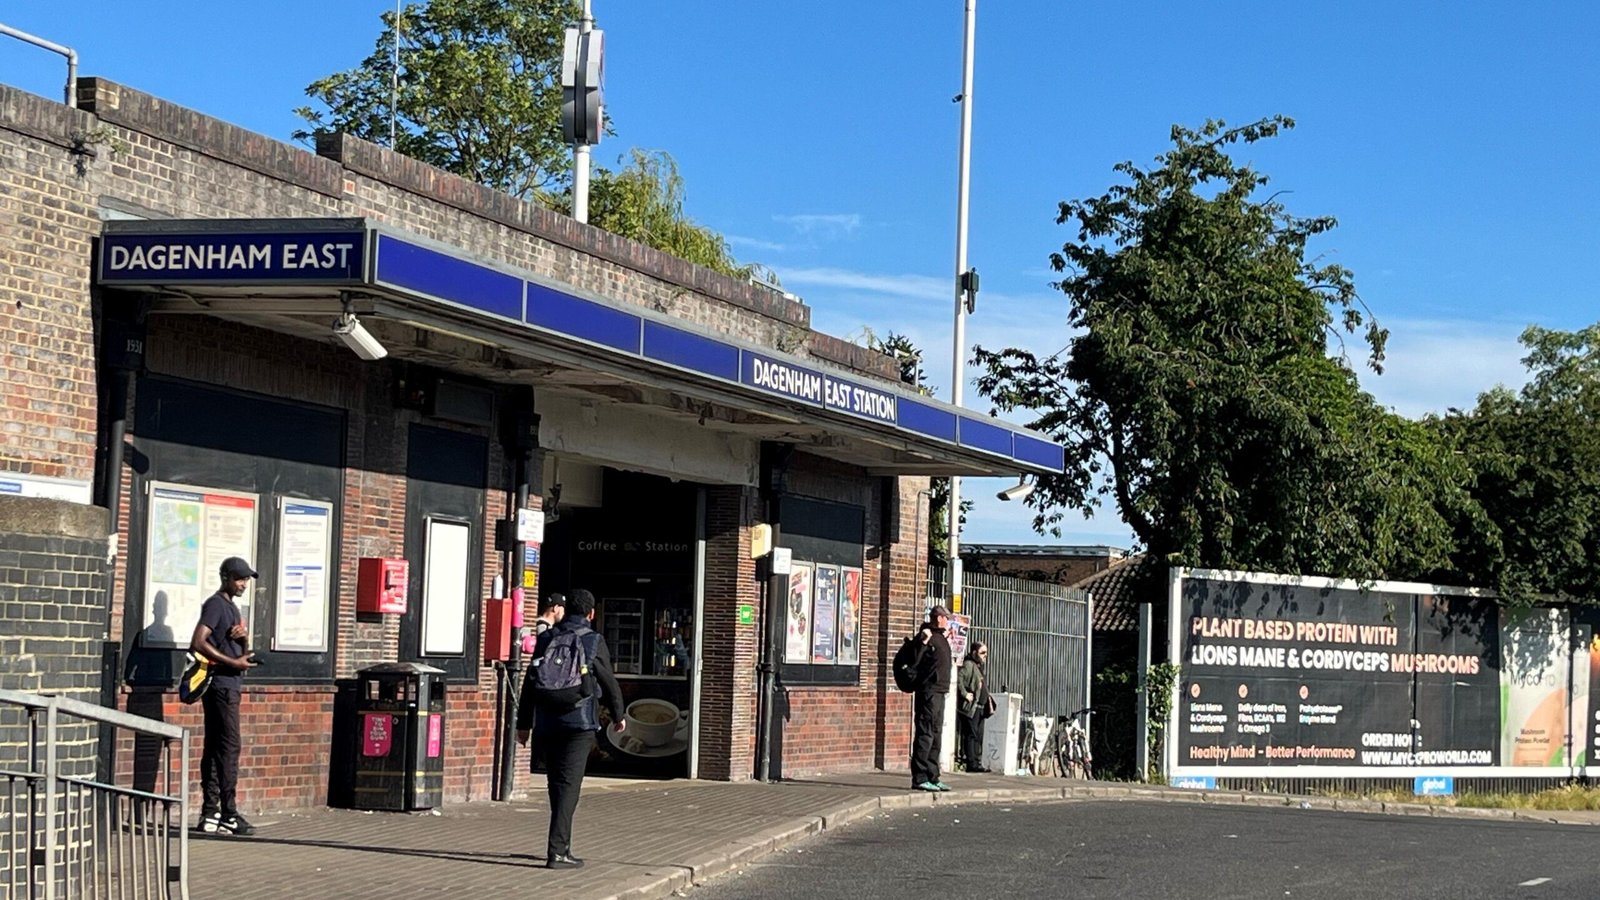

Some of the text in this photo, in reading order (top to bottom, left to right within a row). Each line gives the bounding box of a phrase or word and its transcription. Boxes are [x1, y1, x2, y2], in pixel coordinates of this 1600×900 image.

[110, 243, 353, 270] DAGENHAM EAST
[753, 358, 895, 421] DAGENHAM EAST STATION
[578, 541, 688, 552] Coffee Station
[1192, 617, 1398, 646] PLANT BASED PROTEIN WITH
[1191, 645, 1480, 674] LIONS MANE & CORDYCEPS MUSHROOMS
[1265, 724, 1270, 733] 3
[1362, 733, 1422, 747] ORDER NO:
[1190, 745, 1229, 762] Healthy
[1230, 745, 1255, 759] Mind
[1266, 745, 1294, 758] Better
[1296, 745, 1355, 759] Performance
